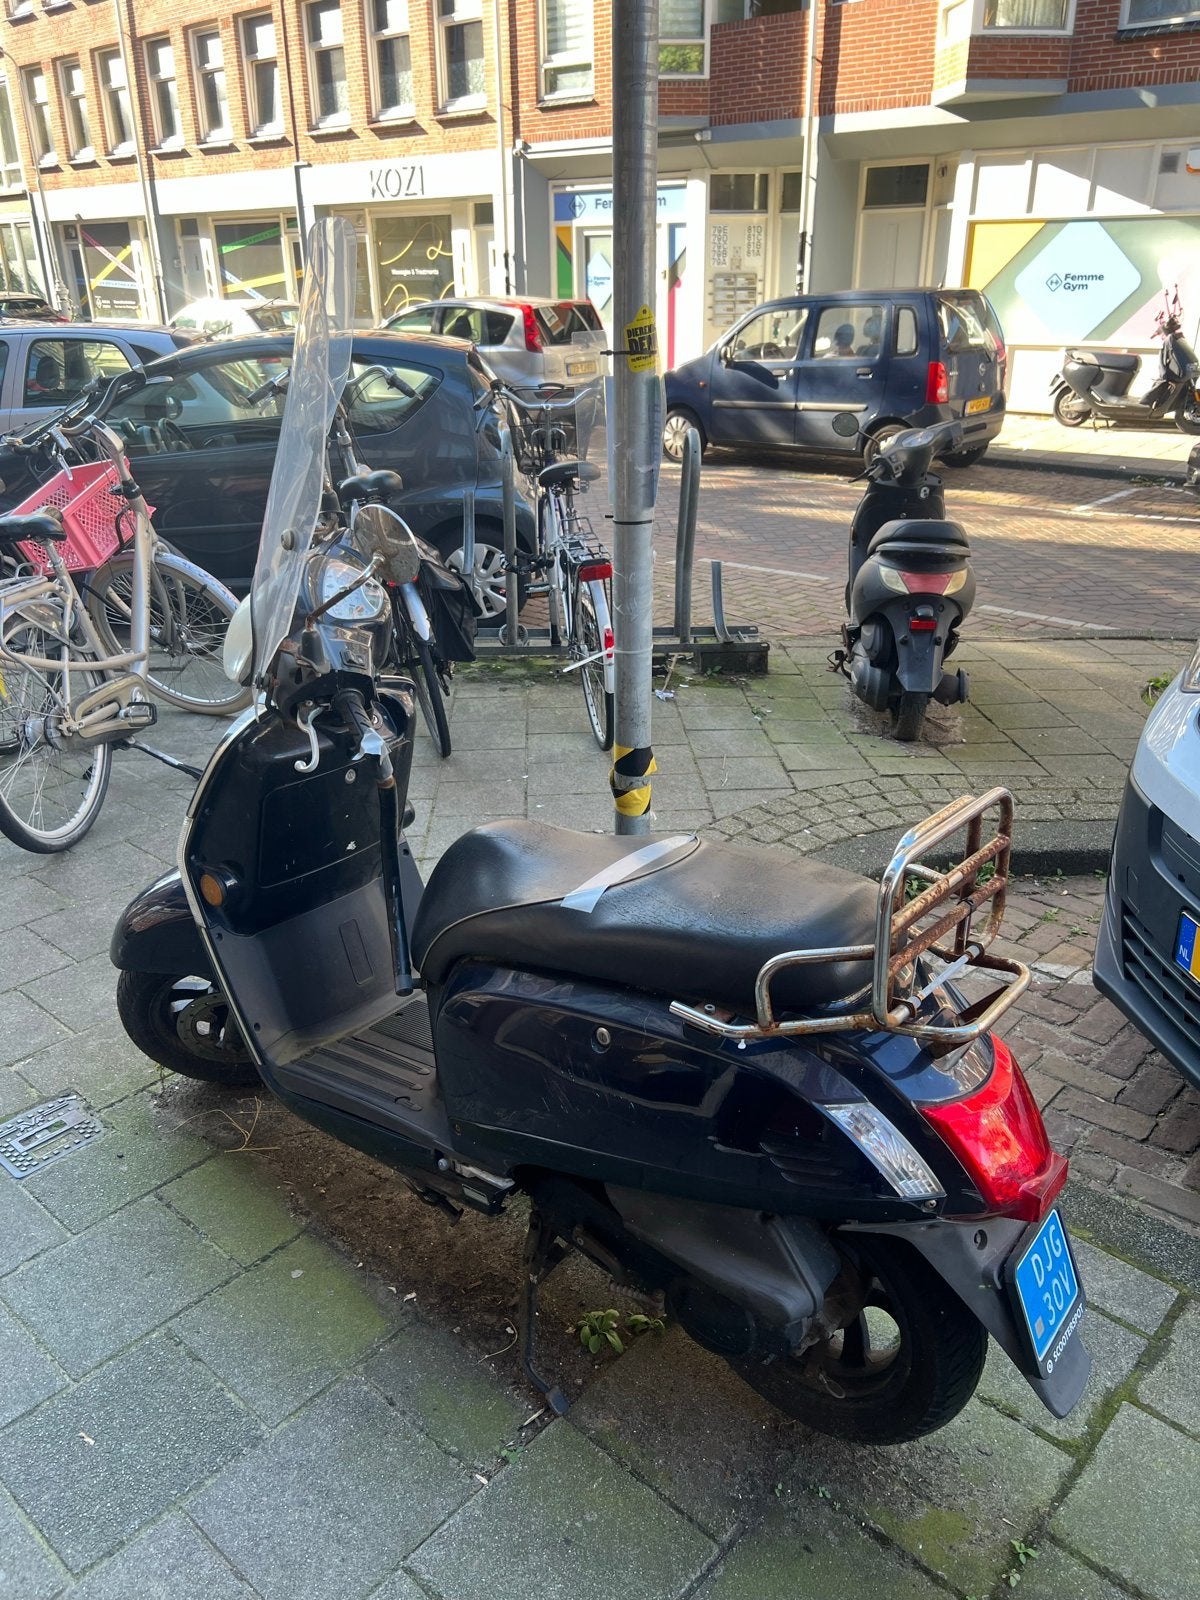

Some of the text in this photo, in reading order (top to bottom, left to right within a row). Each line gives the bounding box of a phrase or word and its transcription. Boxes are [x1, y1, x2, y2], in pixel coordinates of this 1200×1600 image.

[370, 164, 425, 199] KOZI
[1063, 282, 1089, 292] Gym
[1064, 273, 1105, 282] Femme
[1179, 945, 1190, 962] NL
[1030, 1224, 1063, 1289] DJG
[1052, 1302, 1085, 1363] SCOOTERSPOT
